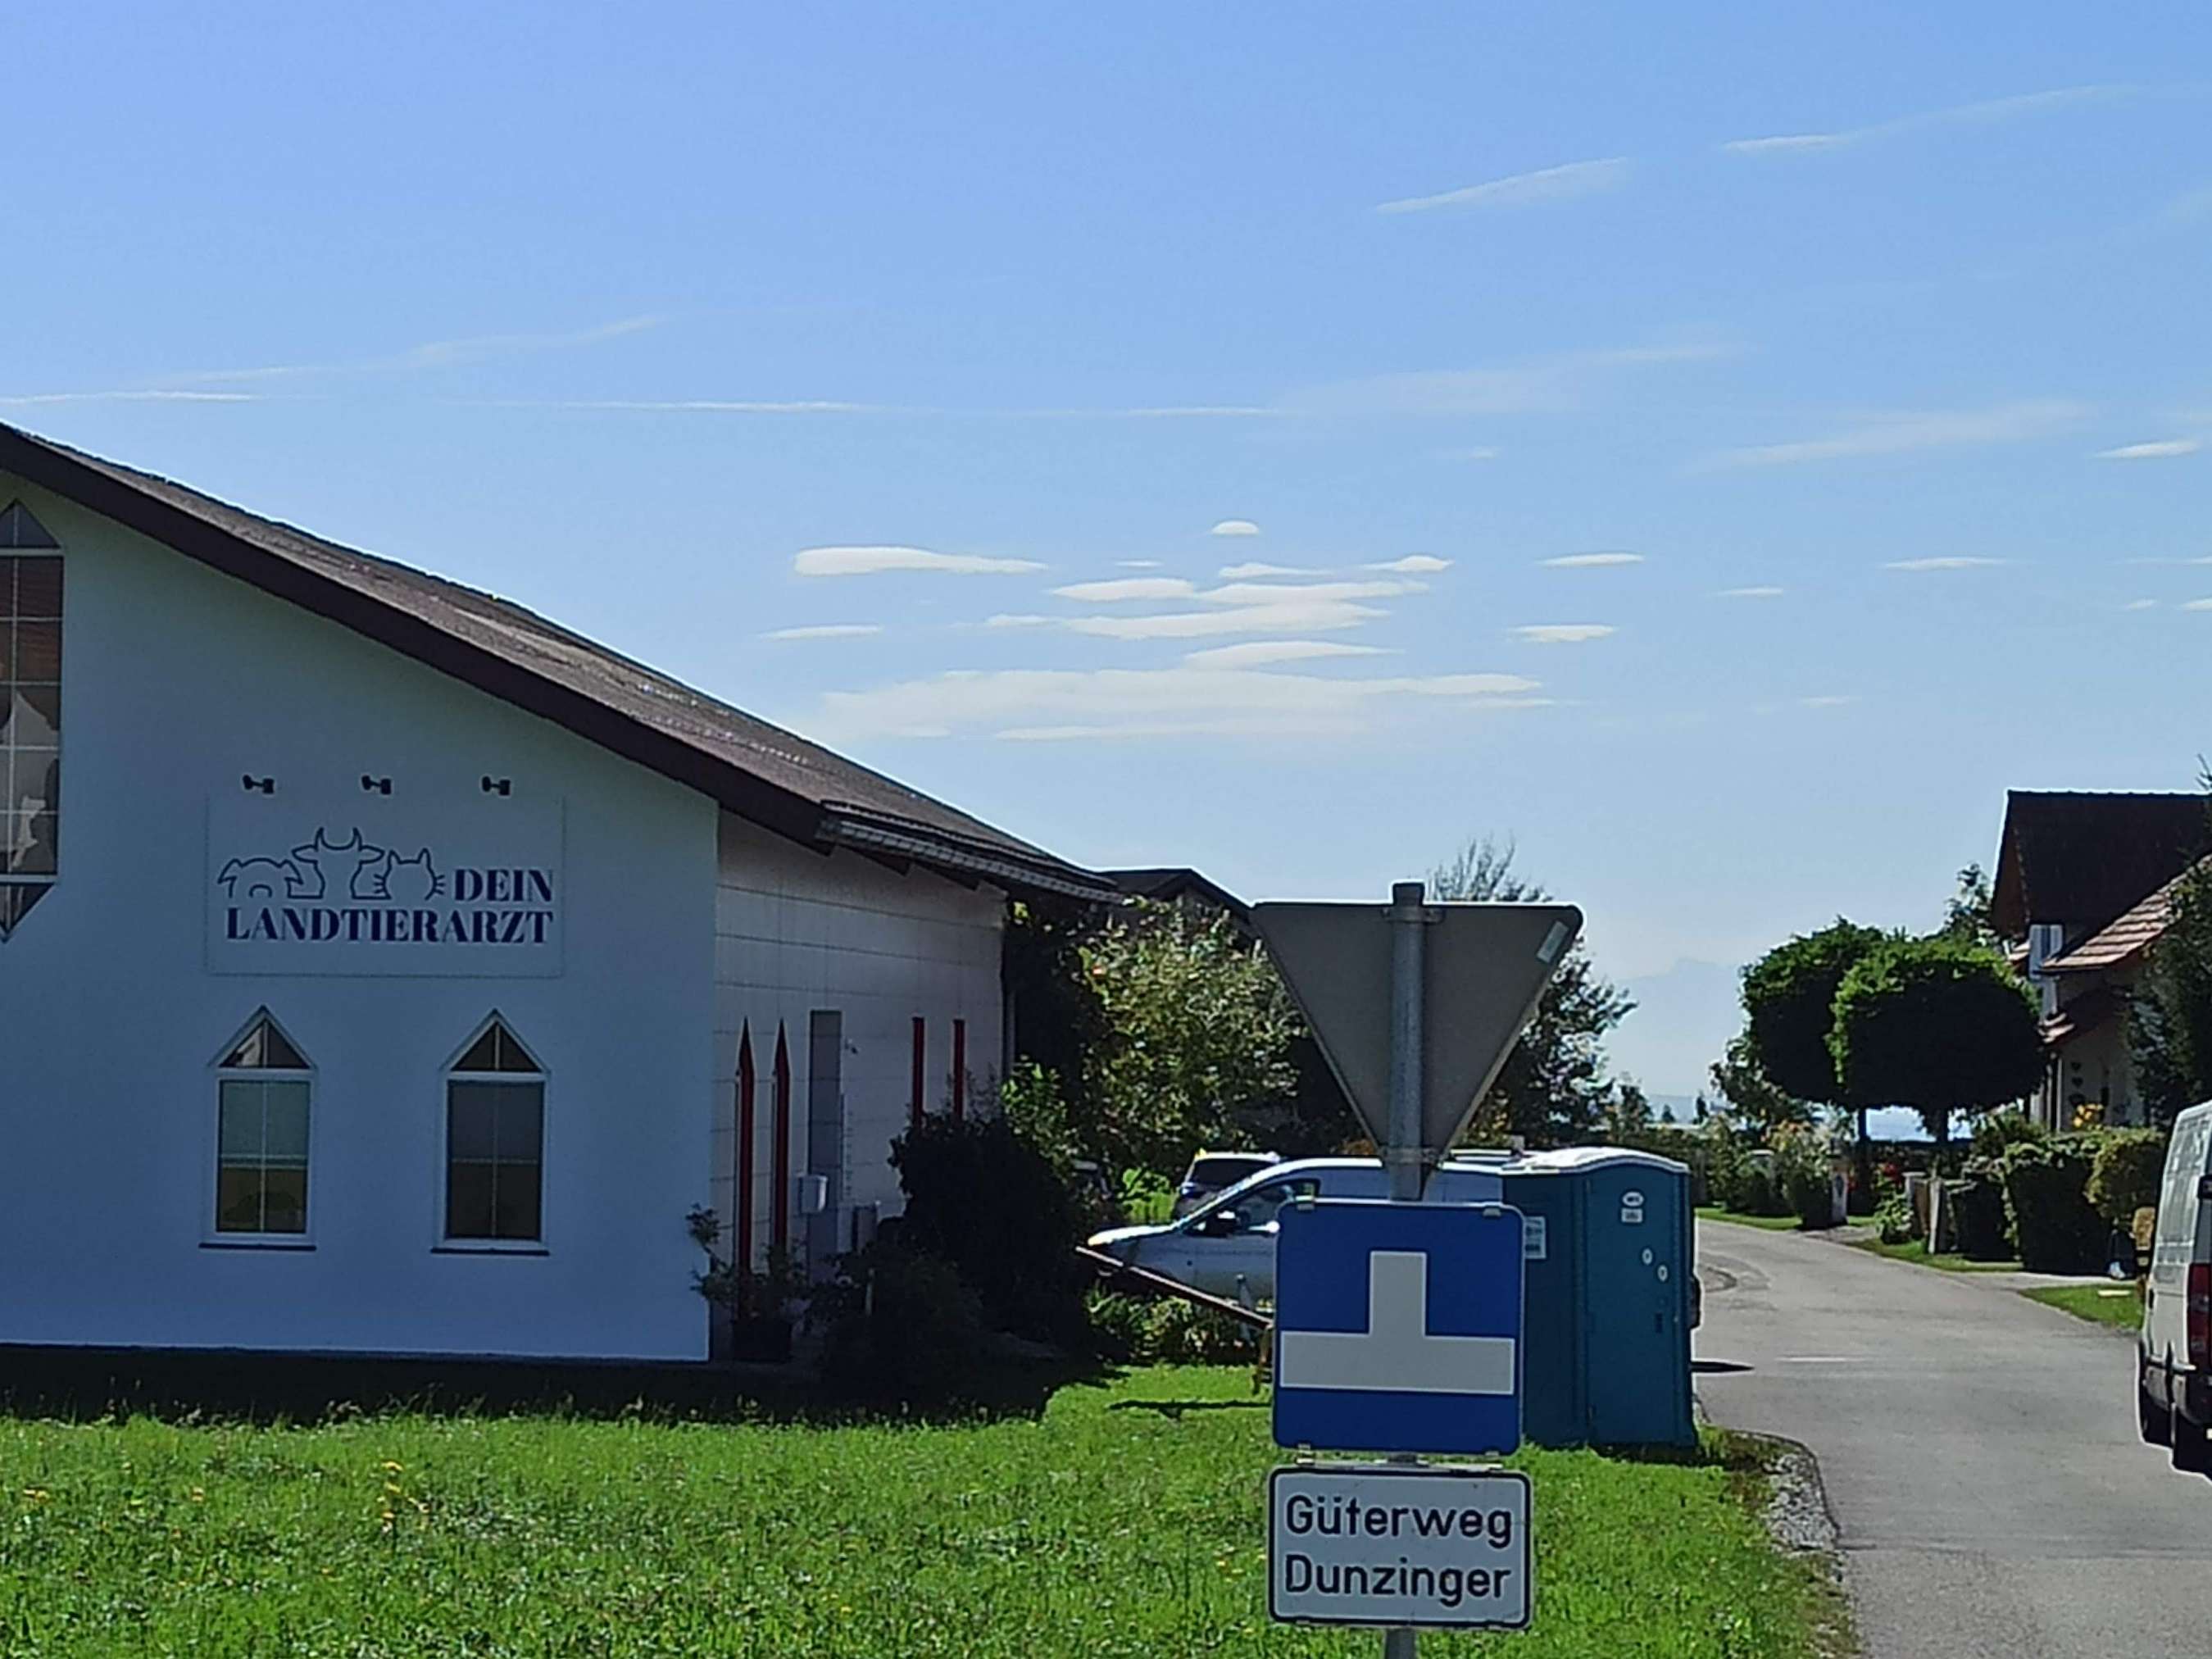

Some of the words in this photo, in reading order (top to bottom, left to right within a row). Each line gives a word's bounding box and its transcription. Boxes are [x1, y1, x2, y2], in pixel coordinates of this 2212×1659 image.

[454, 869, 553, 902] DEIN
[226, 907, 554, 943] LANDTIERARZT
[1286, 1494, 1512, 1549] Güterweg
[1285, 1554, 1512, 1607] Dunzinger
